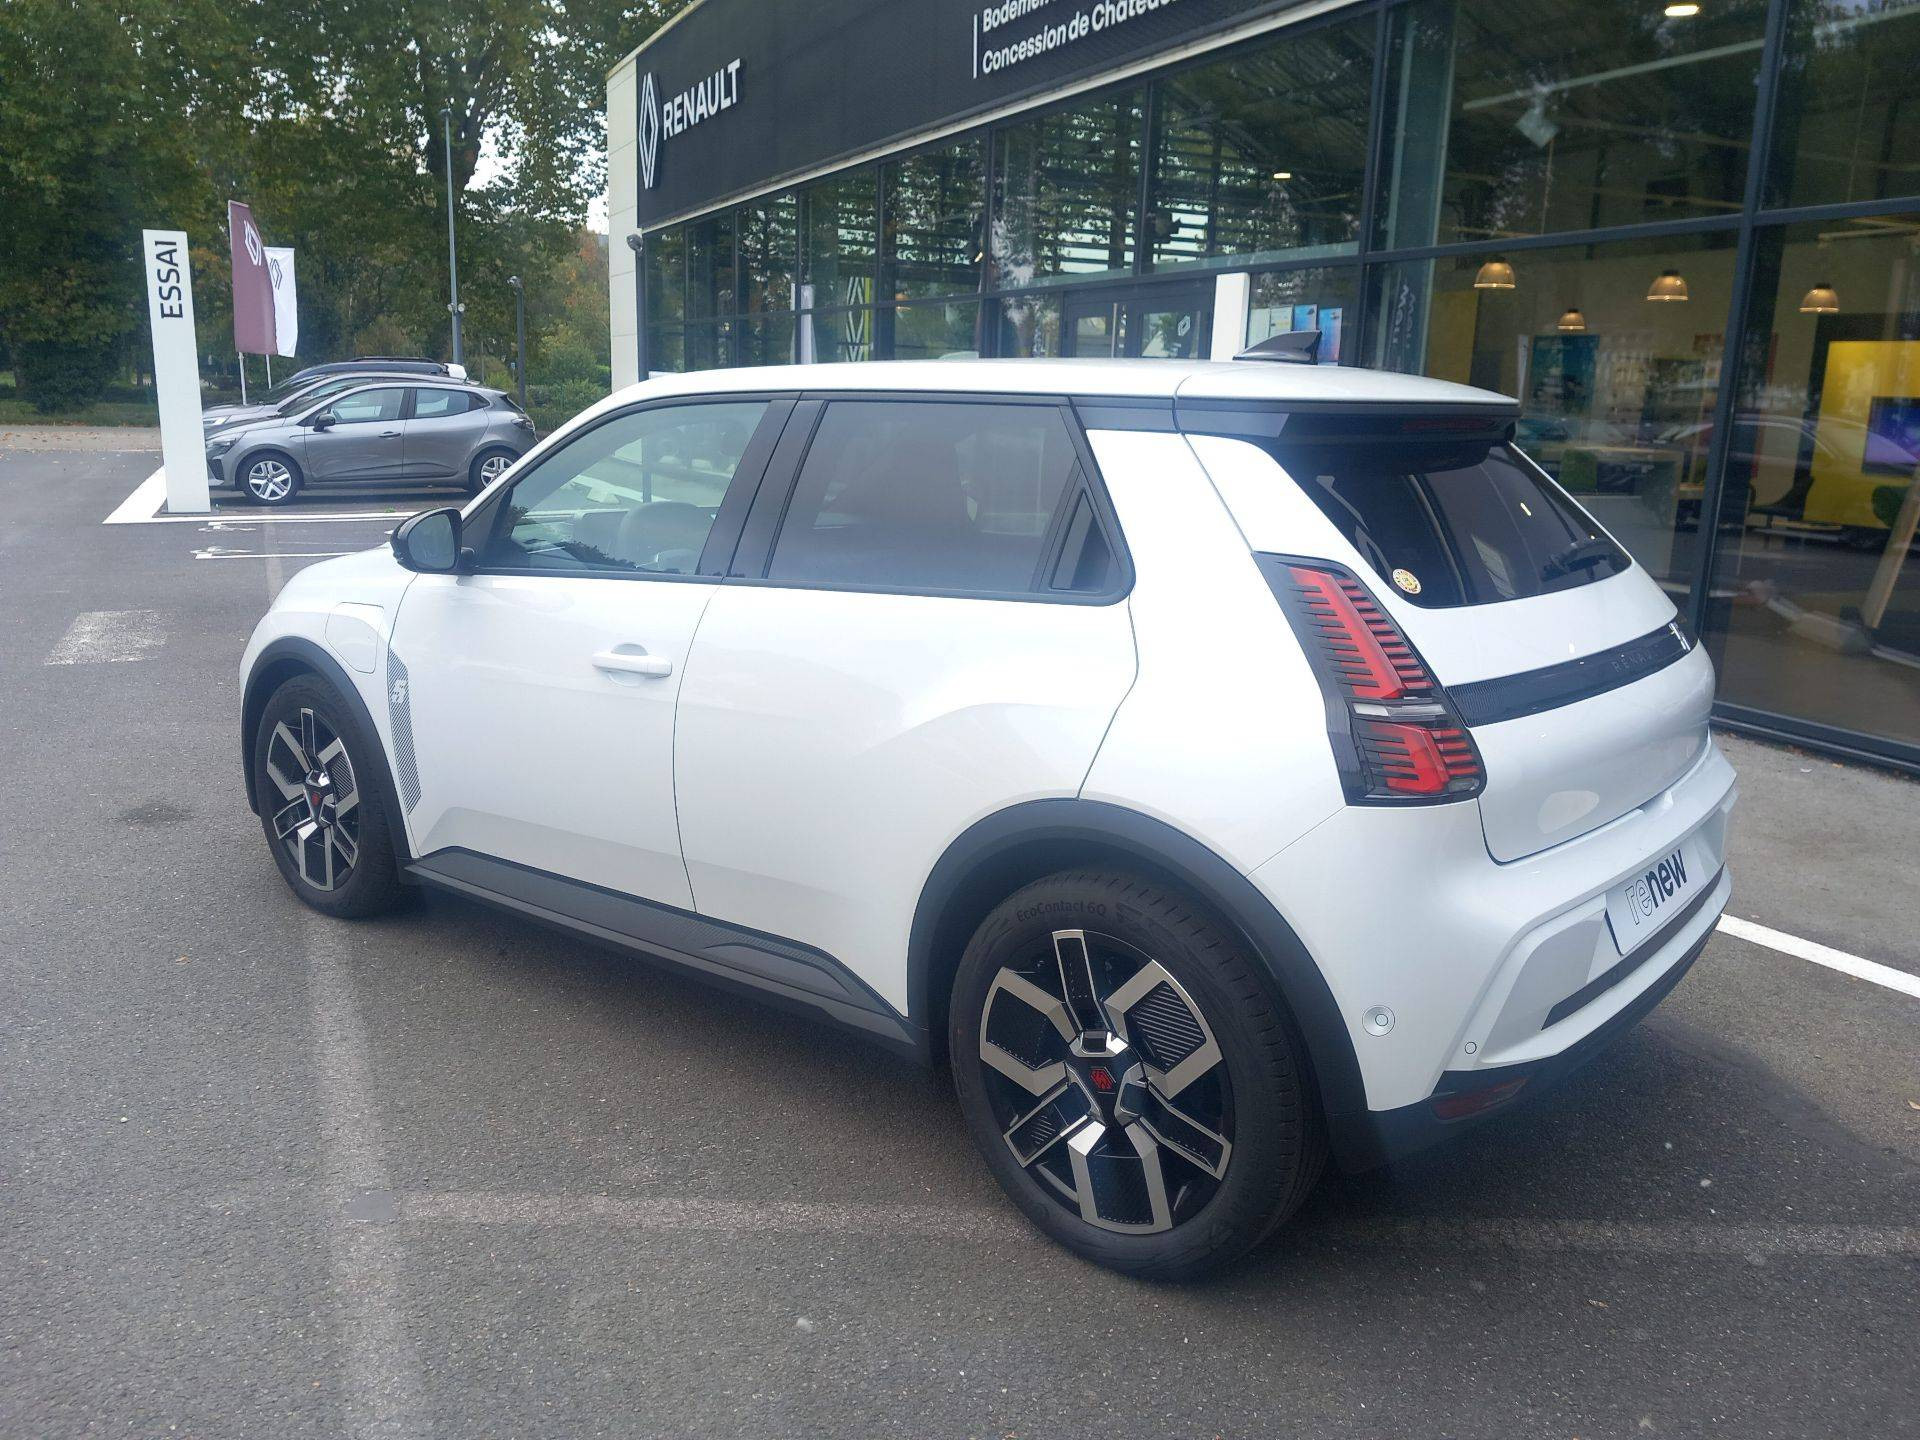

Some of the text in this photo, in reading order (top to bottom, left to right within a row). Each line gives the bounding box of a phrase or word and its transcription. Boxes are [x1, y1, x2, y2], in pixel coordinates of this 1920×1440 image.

[982, 24, 1067, 74] Concession
[1067, 11, 1090, 41] de
[663, 57, 741, 141] RENAULT
[155, 240, 183, 319] ESSAI
[1016, 900, 1084, 922] EcoContact
[1624, 848, 1687, 926] renew
